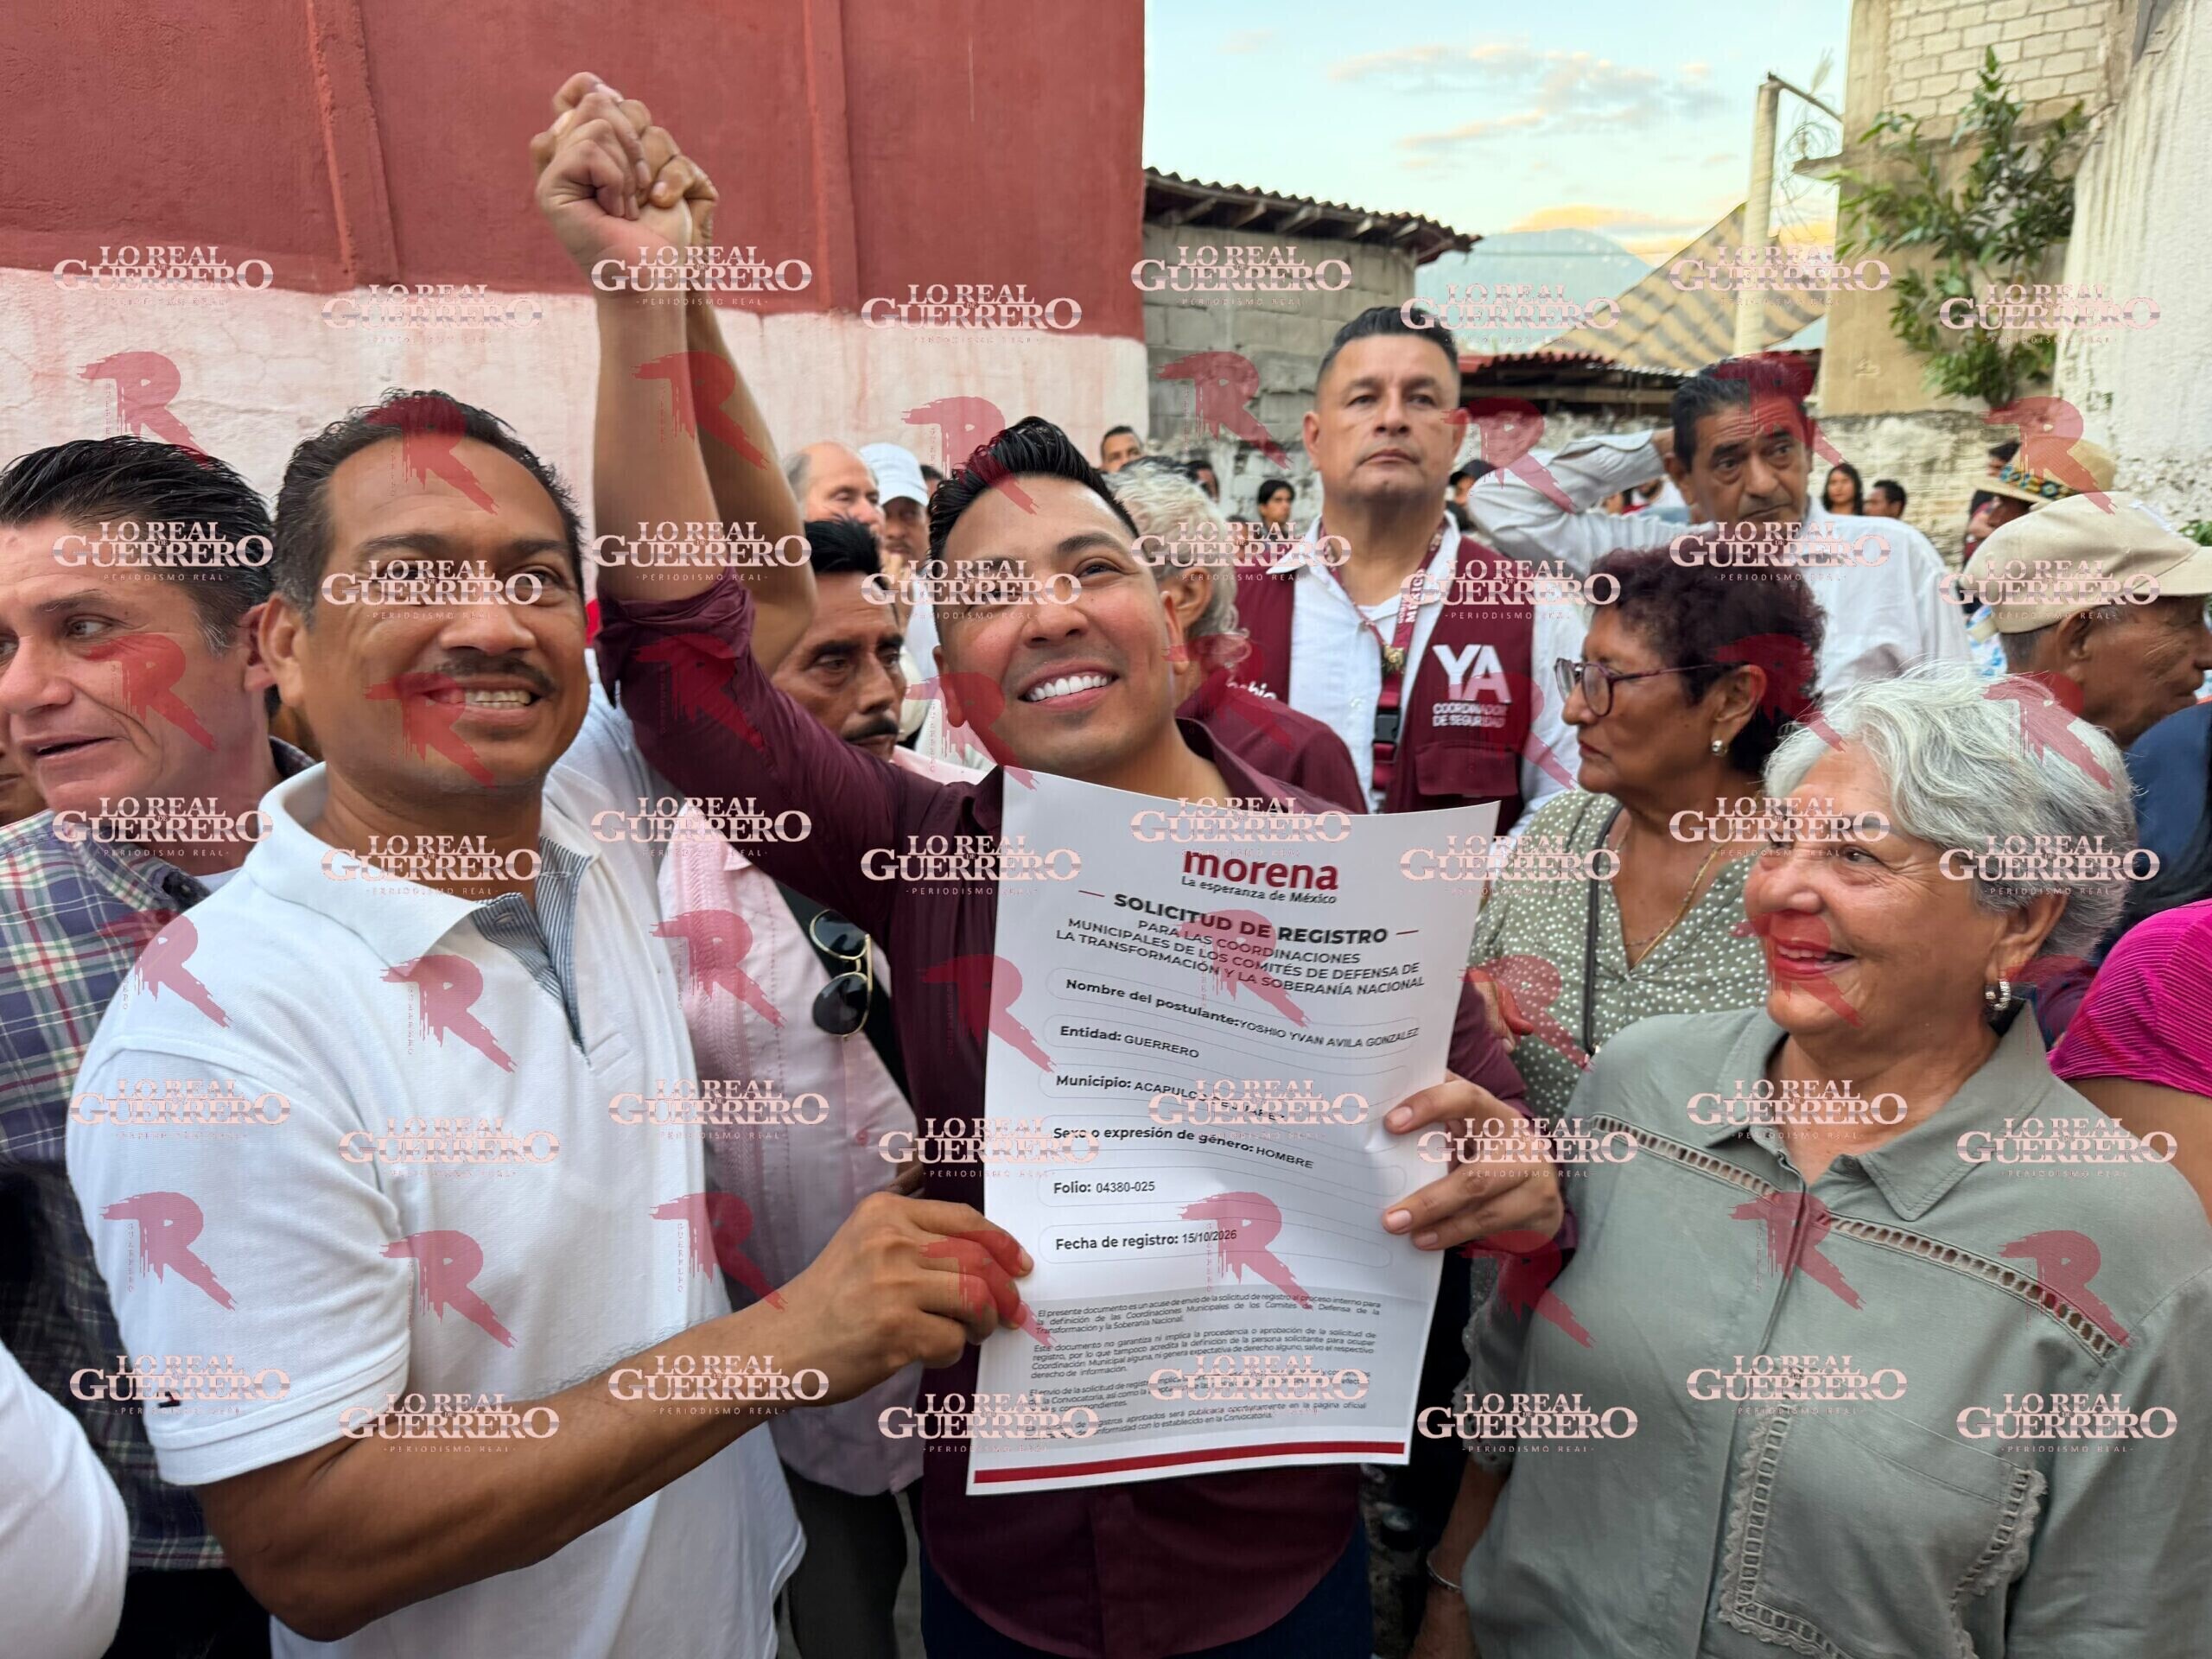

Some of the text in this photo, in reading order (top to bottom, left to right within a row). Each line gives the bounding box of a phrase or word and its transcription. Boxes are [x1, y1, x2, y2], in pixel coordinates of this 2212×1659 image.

[1432, 644, 1512, 704] YA
[1433, 715, 1447, 727] DE
[1181, 876, 1337, 904] La esperanza de México
[1183, 850, 1338, 891] morena
[1114, 893, 1388, 944] SOLICITUD DE REGISTRO
[1056, 930, 1425, 996] LA TRANSFORMACIÓN Y LA SOBERANÍA NACIONAL
[1068, 918, 1421, 980] MUNICIPALES DE LOS COMITÉS DE DEFENSA DE
[1138, 920, 1361, 964] PARA LAS COORDINACIONES
[1065, 979, 1126, 998] Nombre
[1129, 991, 1153, 1004] del
[1156, 997, 1239, 1027] postulante:
[1239, 1020, 1286, 1039] YOSHIO
[1289, 1031, 1325, 1046] YVAN
[1060, 1025, 1200, 1058] Entidad: GUERRERO
[1056, 1074, 1131, 1090] Municipio:
[1091, 1128, 1100, 1139] o
[1104, 1127, 1173, 1141] expresión
[1177, 1129, 1195, 1141] de
[1198, 1131, 1254, 1153] género:
[1255, 1146, 1314, 1170] HOMBRE
[1053, 1180, 1155, 1194] Folio: 04380-025
[1056, 1230, 1237, 1251] Fecha de registro: 15/10/2026
